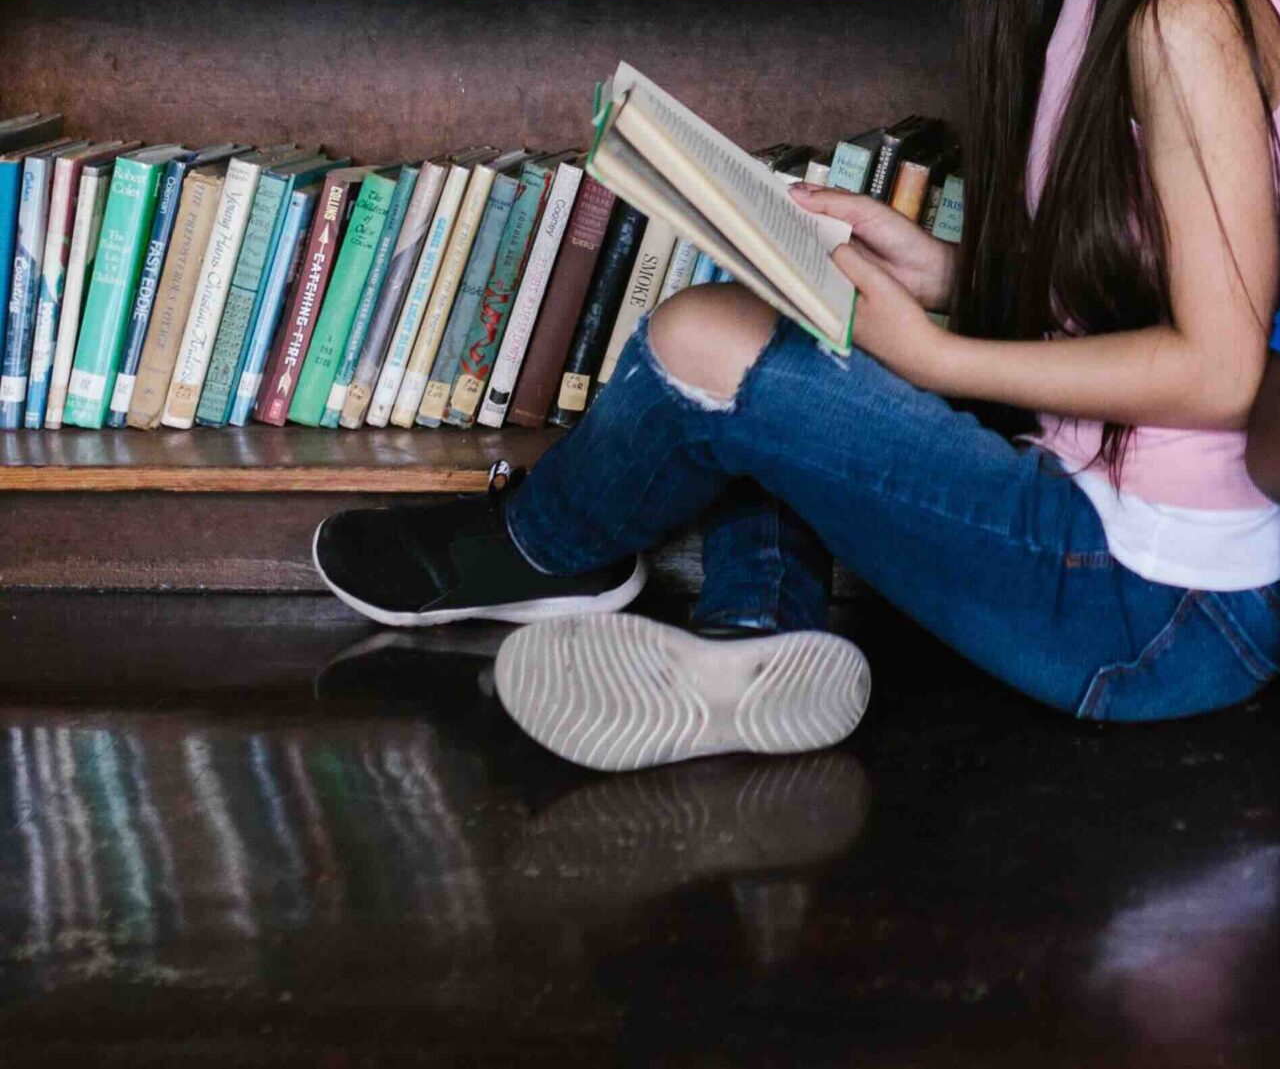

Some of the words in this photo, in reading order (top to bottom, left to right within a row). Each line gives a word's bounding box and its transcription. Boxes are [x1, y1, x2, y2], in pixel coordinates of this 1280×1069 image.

[159, 176, 177, 214] Coleman
[217, 192, 243, 230] Young
[323, 186, 344, 220] COLLINS
[545, 199, 567, 238] Cooney
[143, 240, 164, 274] FAST
[210, 233, 234, 268] Hans
[9, 257, 27, 314] Coasting
[133, 277, 154, 320] EDDIE
[296, 253, 325, 326] CATCHING
[630, 253, 660, 308] SMOKE
[193, 271, 221, 330] Christian
[284, 332, 304, 366] FIRE
